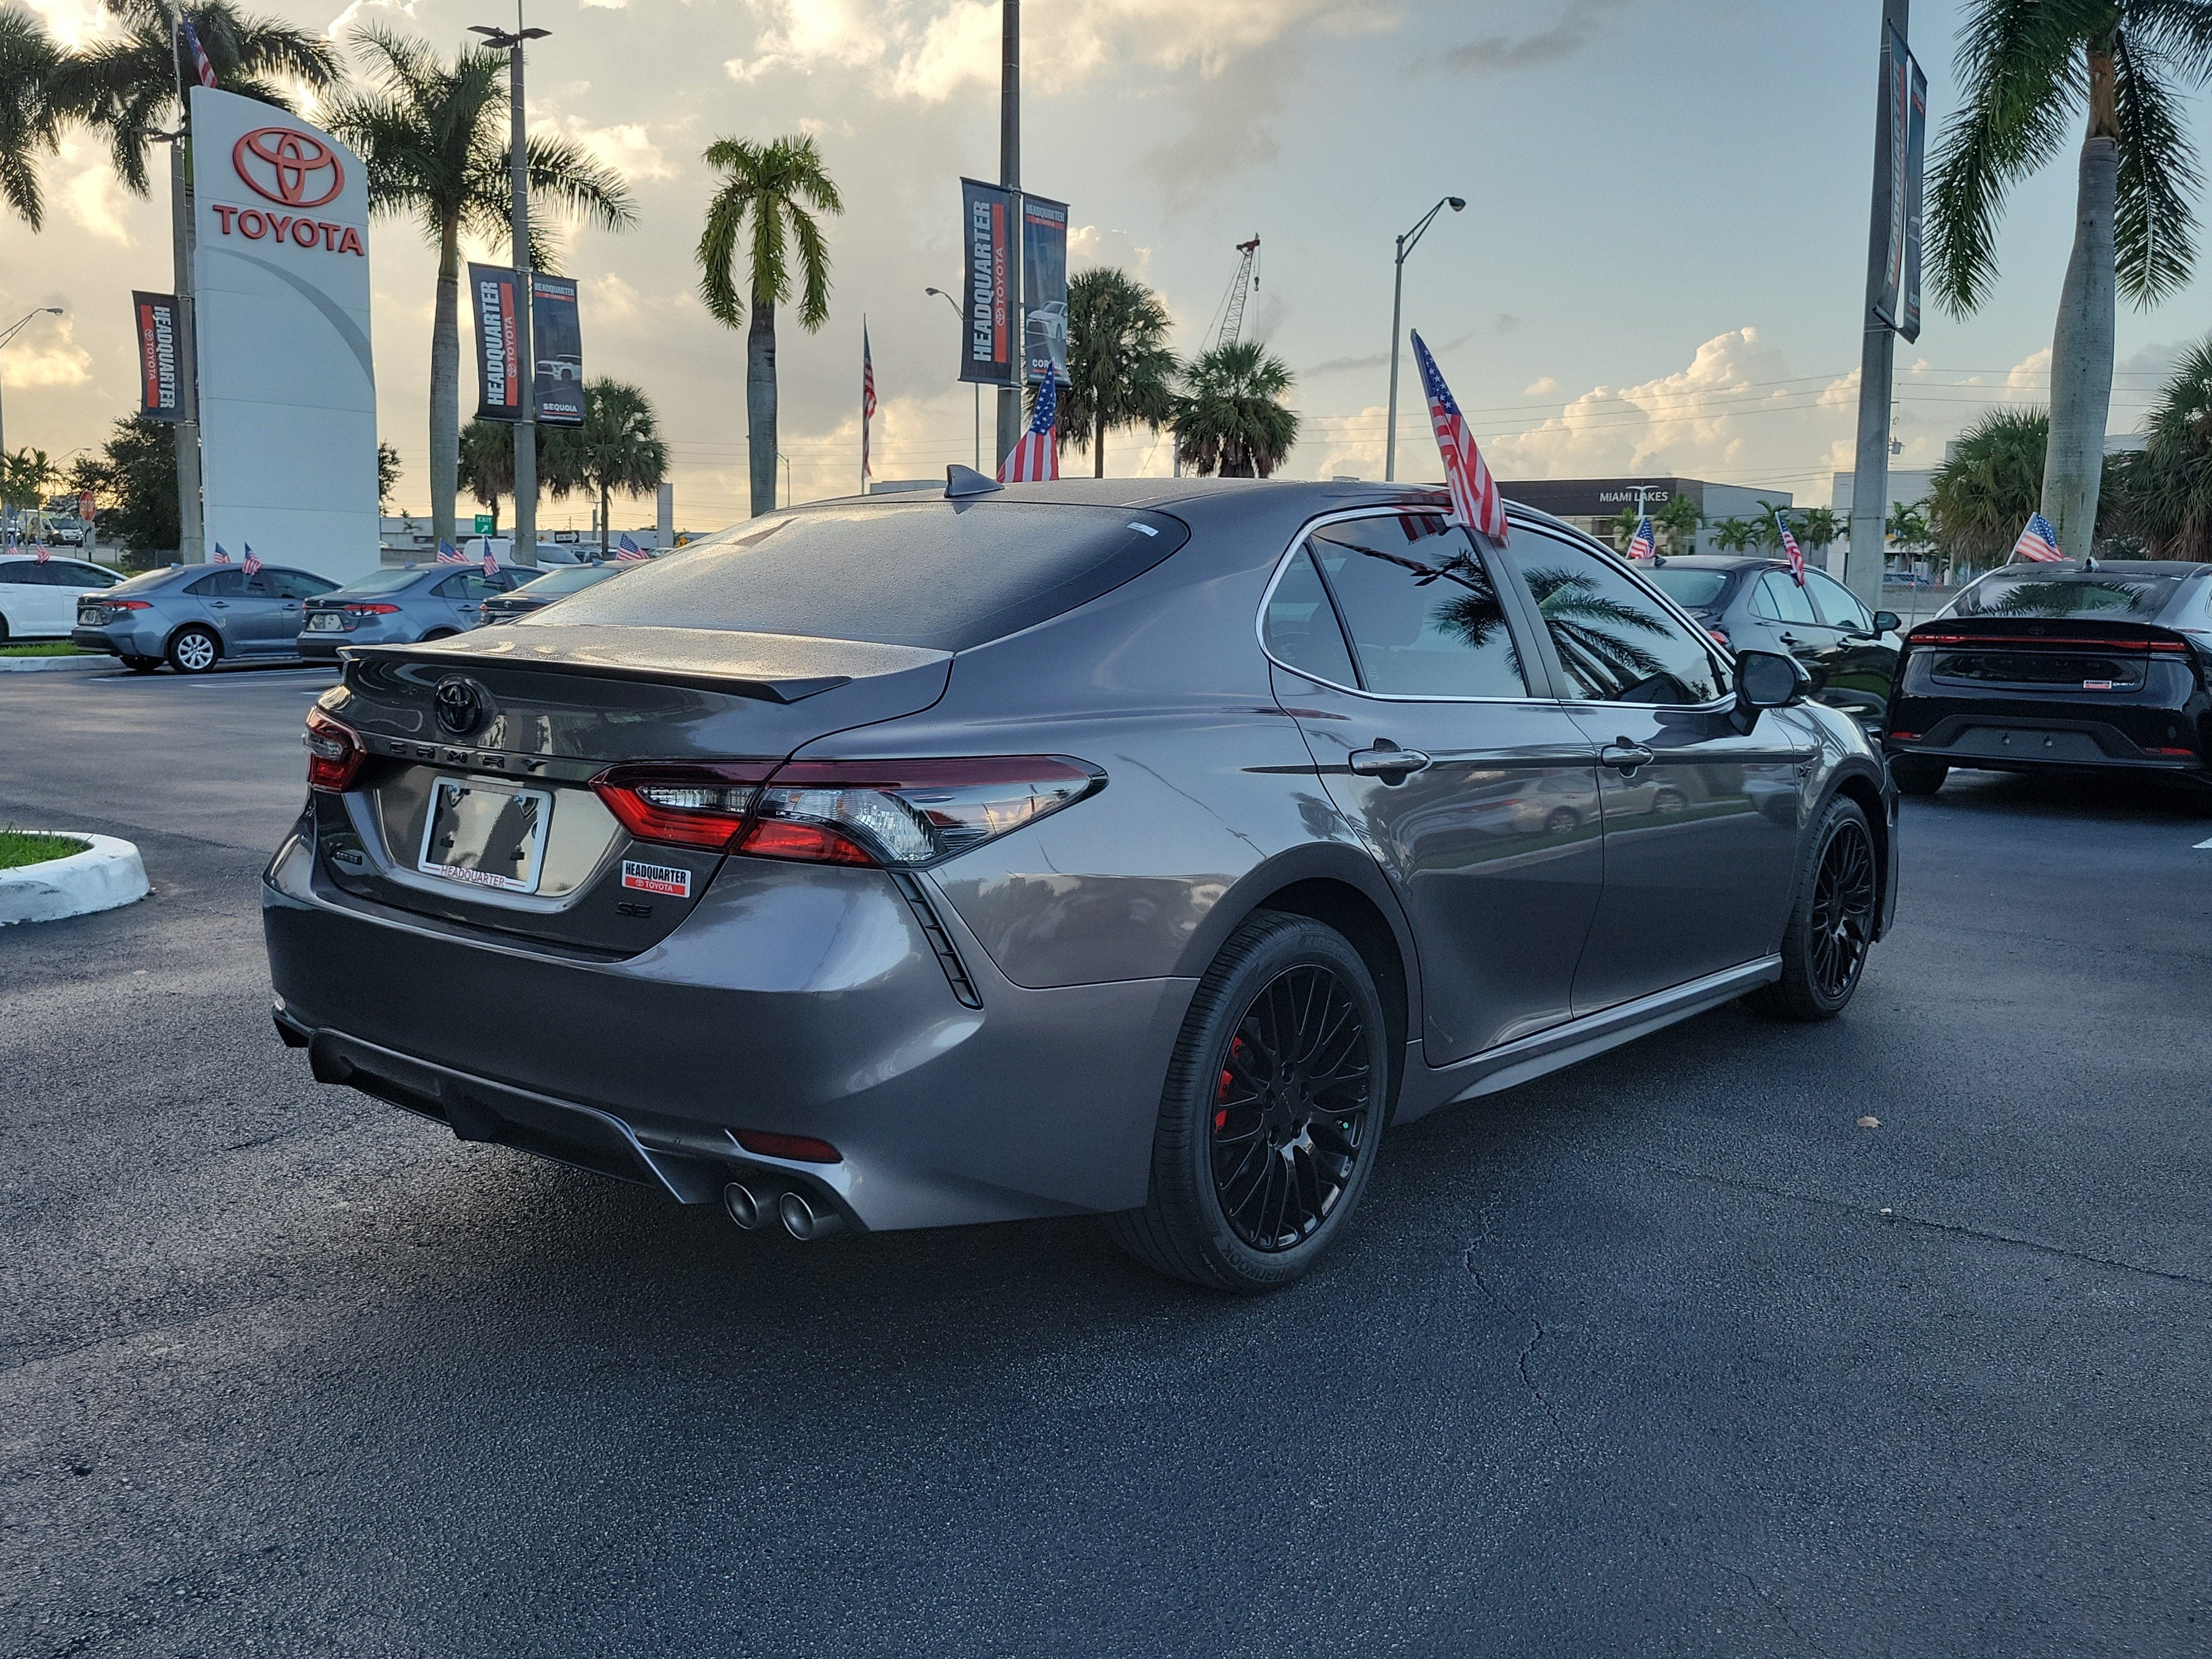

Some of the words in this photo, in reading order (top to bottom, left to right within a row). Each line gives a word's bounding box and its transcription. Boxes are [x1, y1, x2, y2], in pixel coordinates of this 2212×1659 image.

[213, 204, 365, 256] TOYOTA
[534, 283, 575, 296] HEADQUARTER
[974, 201, 994, 362] HEADQUARTER
[996, 247, 1005, 306] TOYOTA
[481, 281, 505, 405] HEADQUARTER
[505, 316, 515, 362] TOYOTA
[146, 342, 156, 380] TOYOTA
[154, 306, 176, 408] HEADQUARTER
[543, 403, 578, 412] SEQUOIA
[81, 500, 95, 512] STOP
[1600, 492, 1631, 502] MIAMI
[389, 741, 548, 772] CAMRY
[441, 865, 505, 887] HEADQUARTER
[625, 862, 686, 884] HEADQUARTER
[645, 881, 673, 892] TOYOTA
